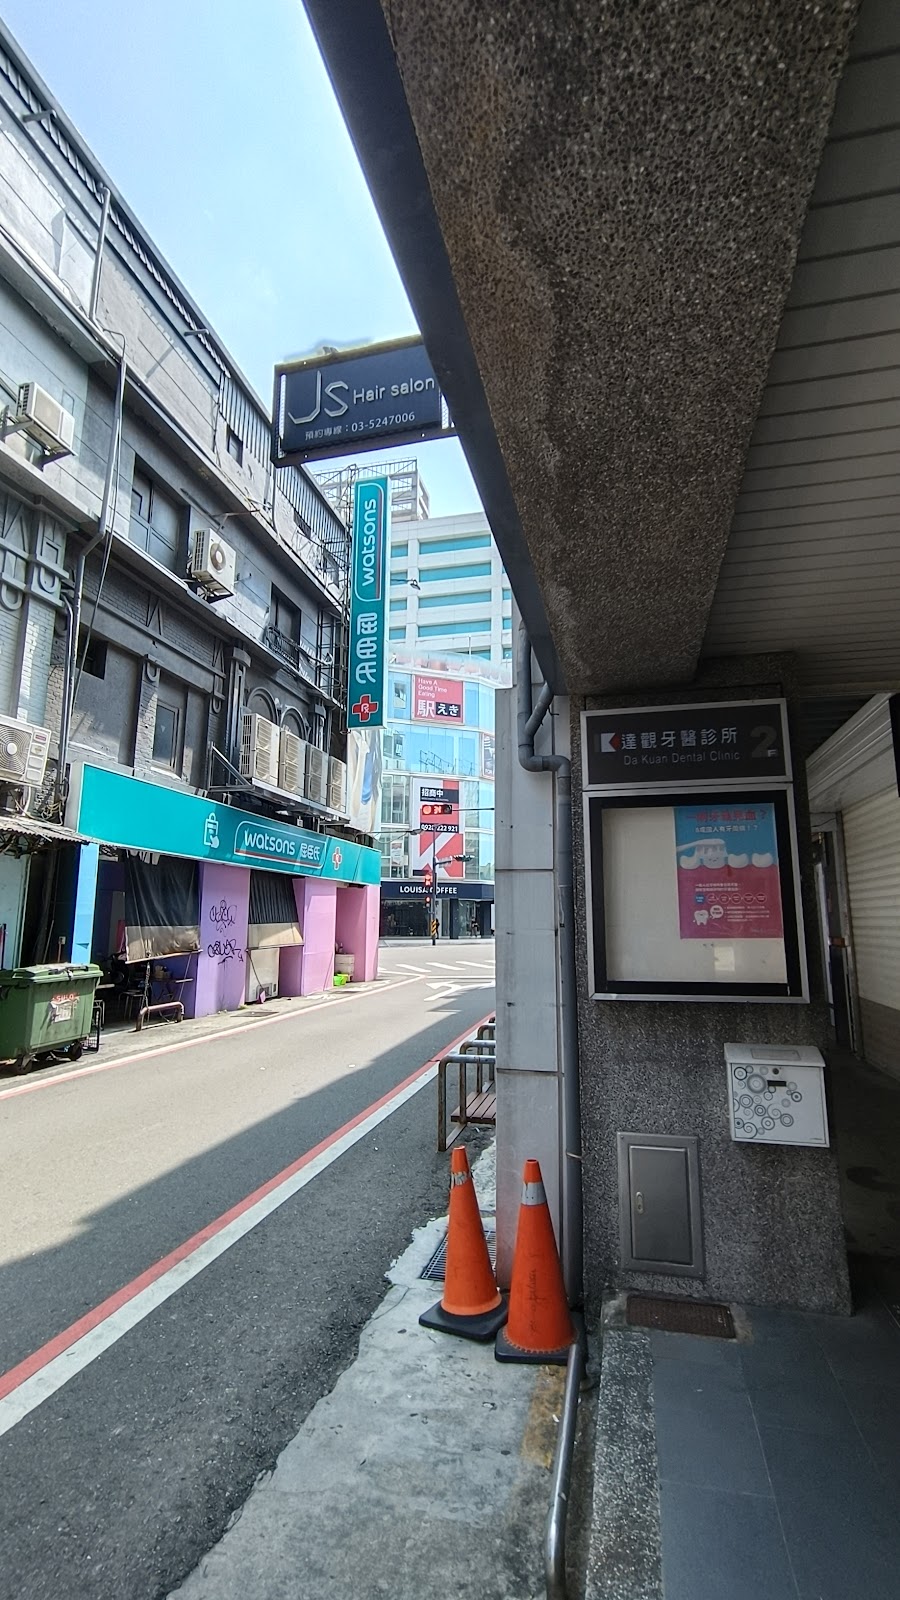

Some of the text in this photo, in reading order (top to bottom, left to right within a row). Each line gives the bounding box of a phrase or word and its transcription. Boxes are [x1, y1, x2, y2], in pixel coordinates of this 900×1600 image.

[288, 370, 435, 425] JS Hair salon
[361, 498, 377, 587] watsons
[355, 612, 378, 684] 屈臣氏
[418, 677, 432, 685] Have
[418, 690, 435, 698] Eating
[621, 726, 737, 751] 達觀牙醫診所
[624, 750, 740, 766] Da Kuan Dental Clinic
[421, 788, 444, 798] 招商中
[244, 827, 321, 861] watsons 屈臣氏
[400, 885, 428, 894] LOUISA
